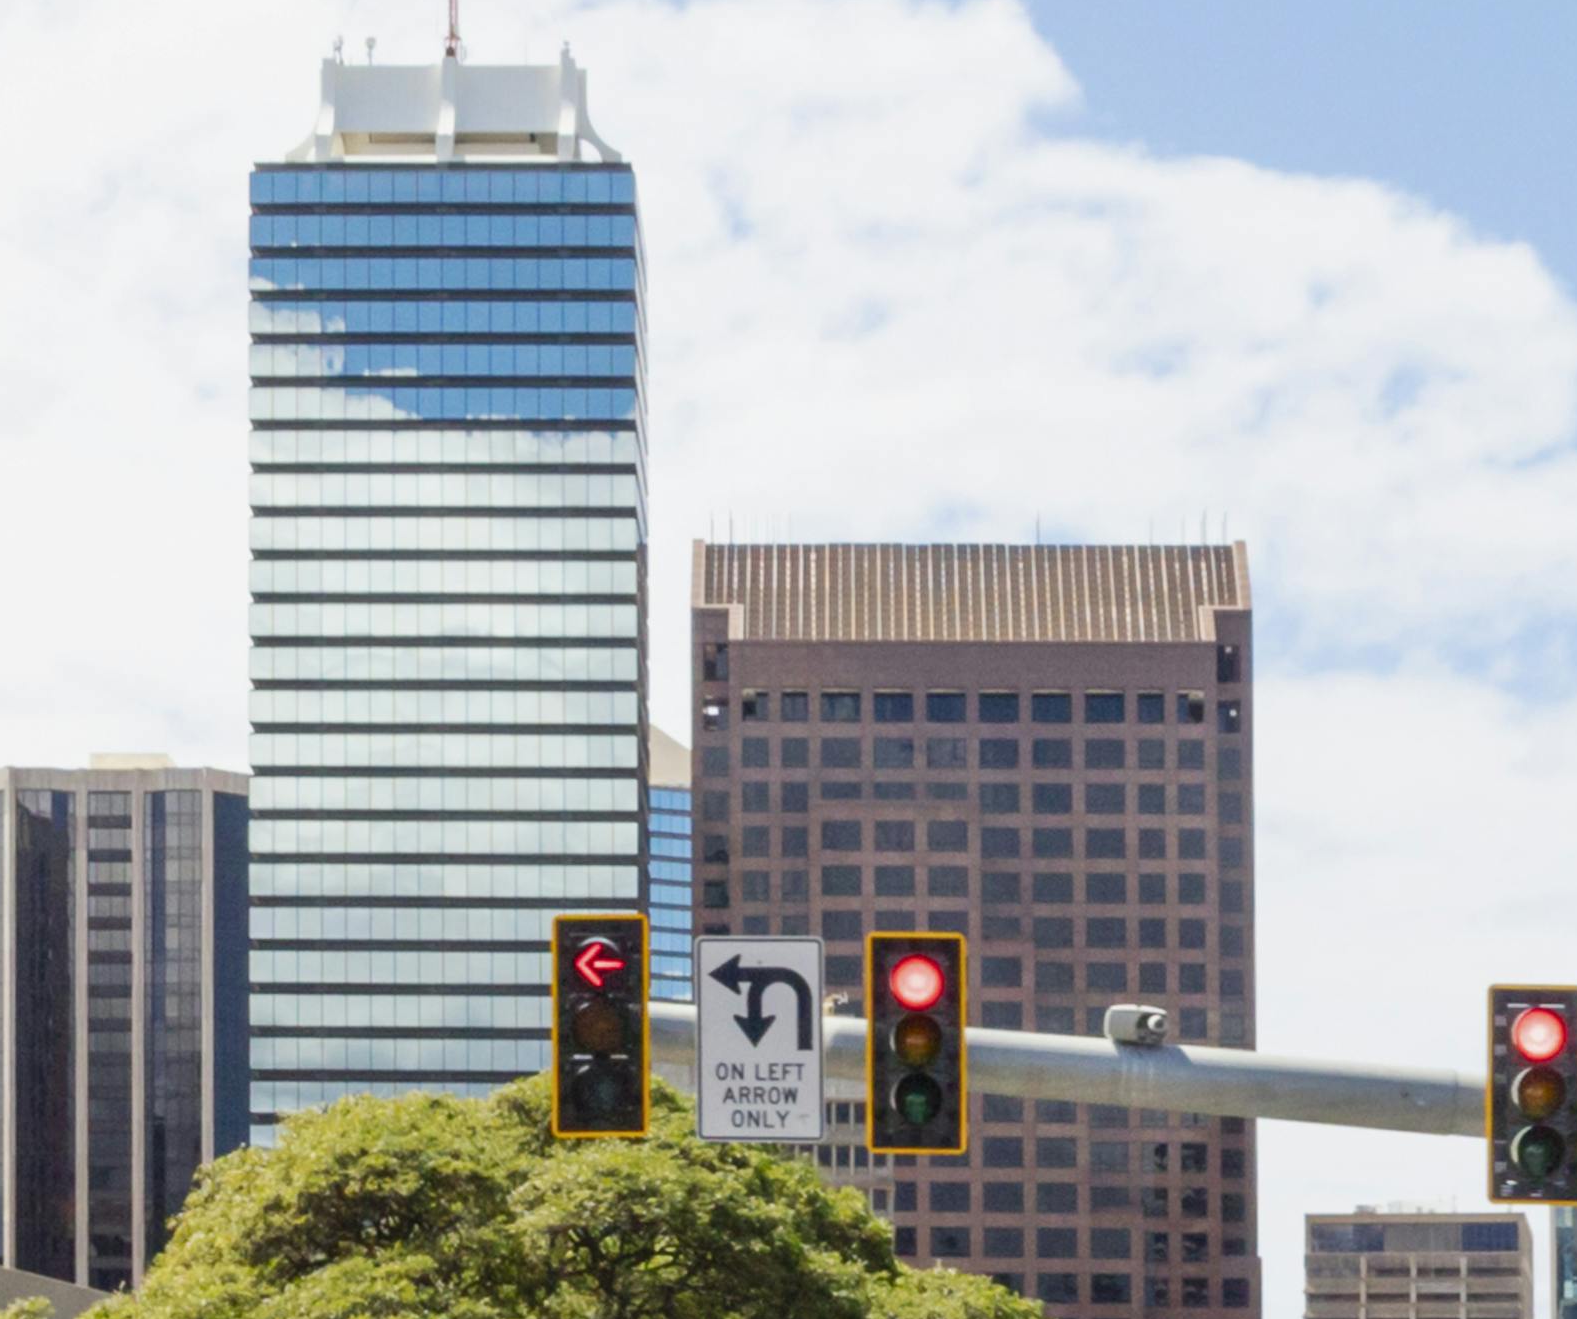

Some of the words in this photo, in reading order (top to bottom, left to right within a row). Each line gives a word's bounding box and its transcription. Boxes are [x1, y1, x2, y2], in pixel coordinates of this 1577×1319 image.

[715, 1062, 745, 1081] ON
[754, 1062, 805, 1081] LEFT
[722, 1086, 799, 1105] ARROW
[731, 1109, 790, 1128] ONLY
